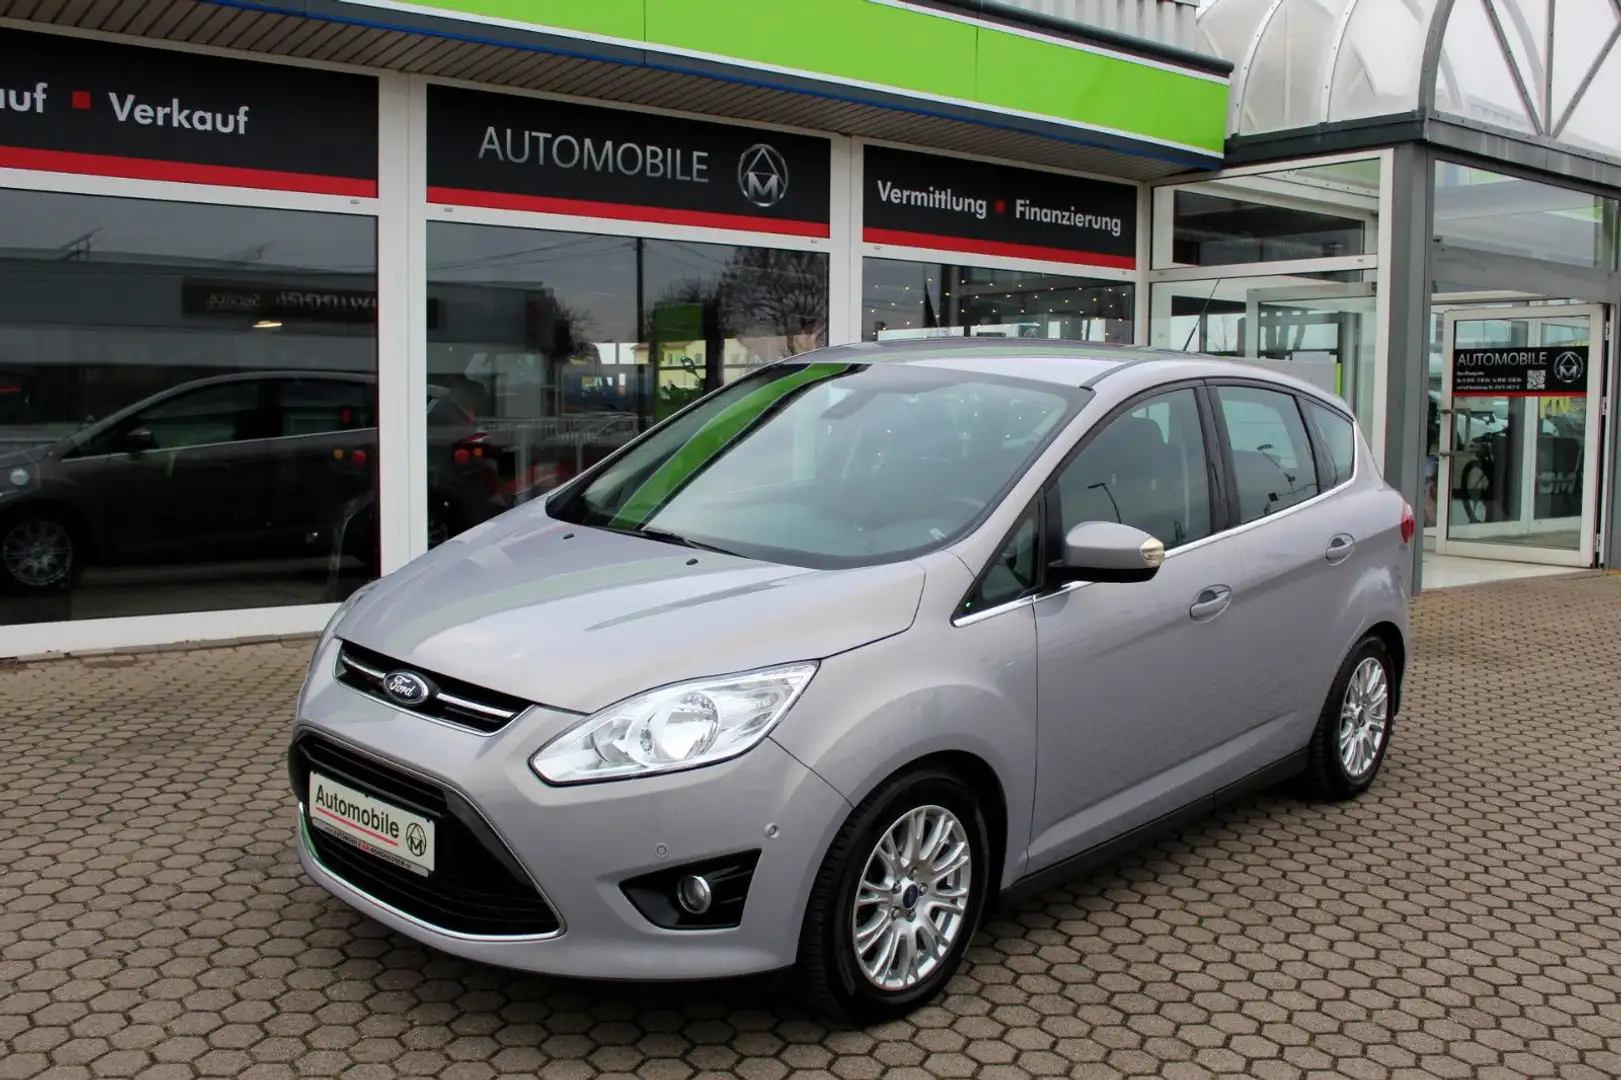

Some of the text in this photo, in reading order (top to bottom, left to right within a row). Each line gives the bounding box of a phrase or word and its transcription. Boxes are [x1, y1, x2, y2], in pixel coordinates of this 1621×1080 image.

[108, 92, 249, 135] Verkauf
[478, 125, 710, 184] AUTOMOBILE
[877, 180, 1121, 237] Vermittlung Finanzierung
[1456, 352, 1548, 366] AUTOMOBILE
[389, 675, 416, 697] Ford
[315, 784, 400, 839] Automobile
